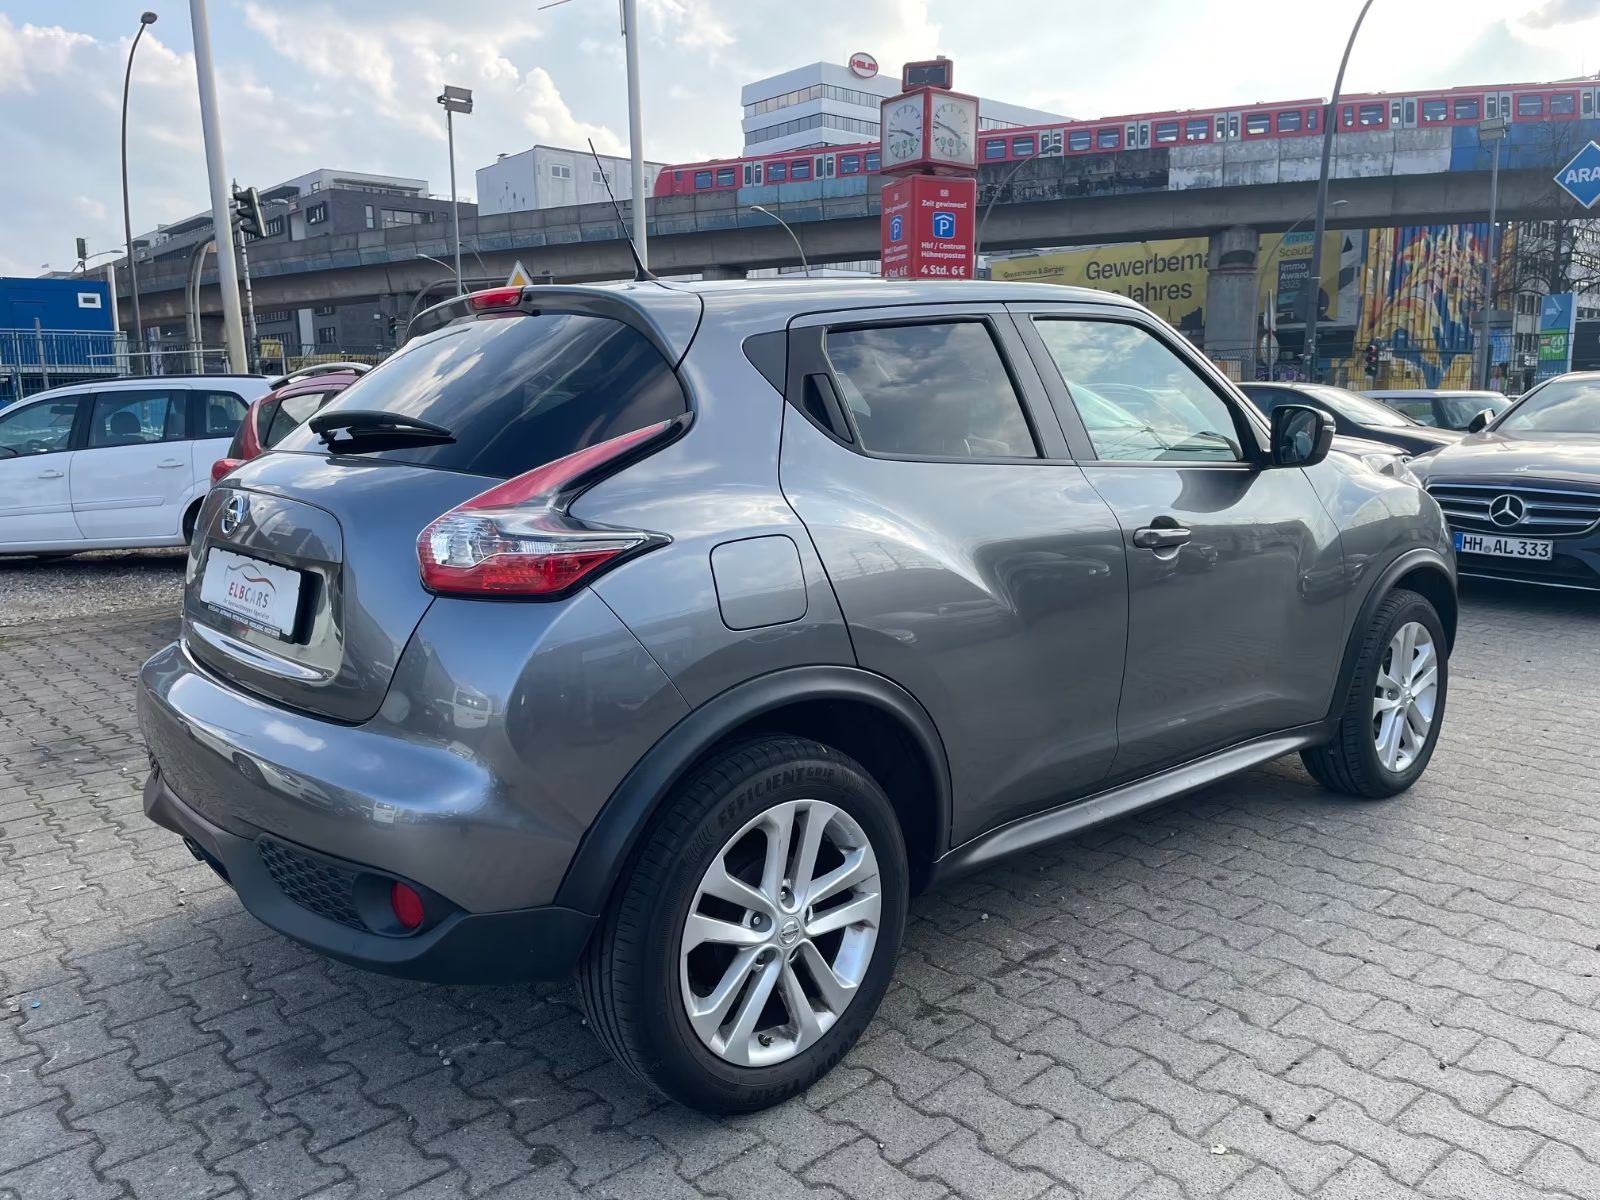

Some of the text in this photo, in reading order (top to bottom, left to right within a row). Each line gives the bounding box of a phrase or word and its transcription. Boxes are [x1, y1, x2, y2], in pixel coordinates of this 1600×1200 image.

[940, 220, 949, 235] P
[921, 265, 929, 275] 4
[930, 265, 949, 275] Std.
[1281, 263, 1307, 272] Immo
[1280, 271, 1310, 281] Award
[1128, 282, 1192, 302] Jahres
[1463, 536, 1550, 558] HH AL 333
[228, 582, 270, 609] ELBCARS
